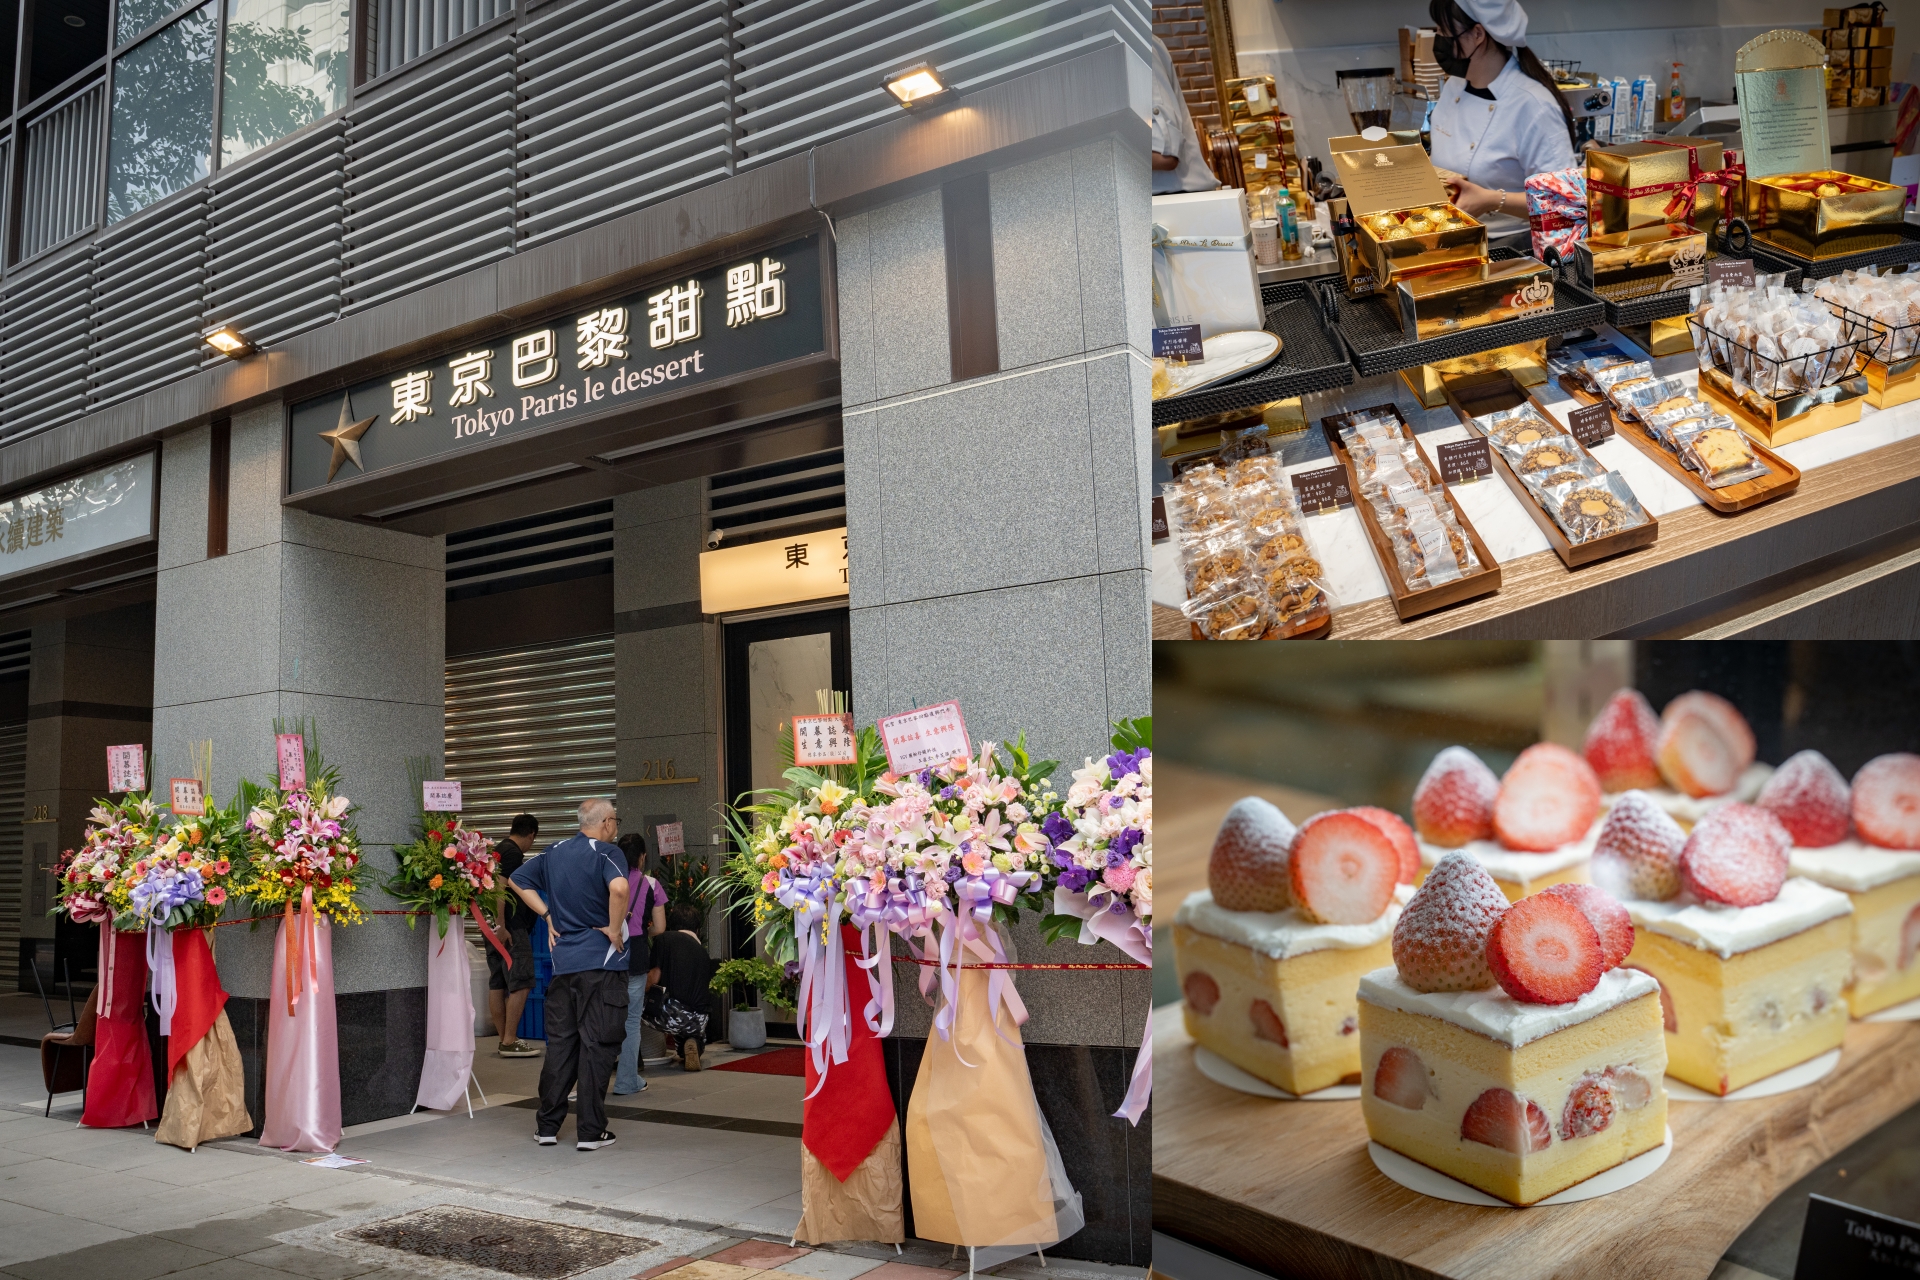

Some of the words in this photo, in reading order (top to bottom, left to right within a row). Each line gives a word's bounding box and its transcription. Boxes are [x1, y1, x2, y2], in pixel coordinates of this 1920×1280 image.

[389, 257, 786, 426] 東京巴黎甜點
[451, 402, 515, 439] Tokyo
[520, 382, 578, 421] Paris
[584, 377, 605, 406] le
[610, 349, 705, 396] dessert
[925, 723, 955, 737] 生意興隆
[801, 736, 852, 750] 生意興隆
[641, 758, 675, 781] 216
[33, 805, 48, 820] 218
[1845, 1218, 1896, 1247] Tokyo
